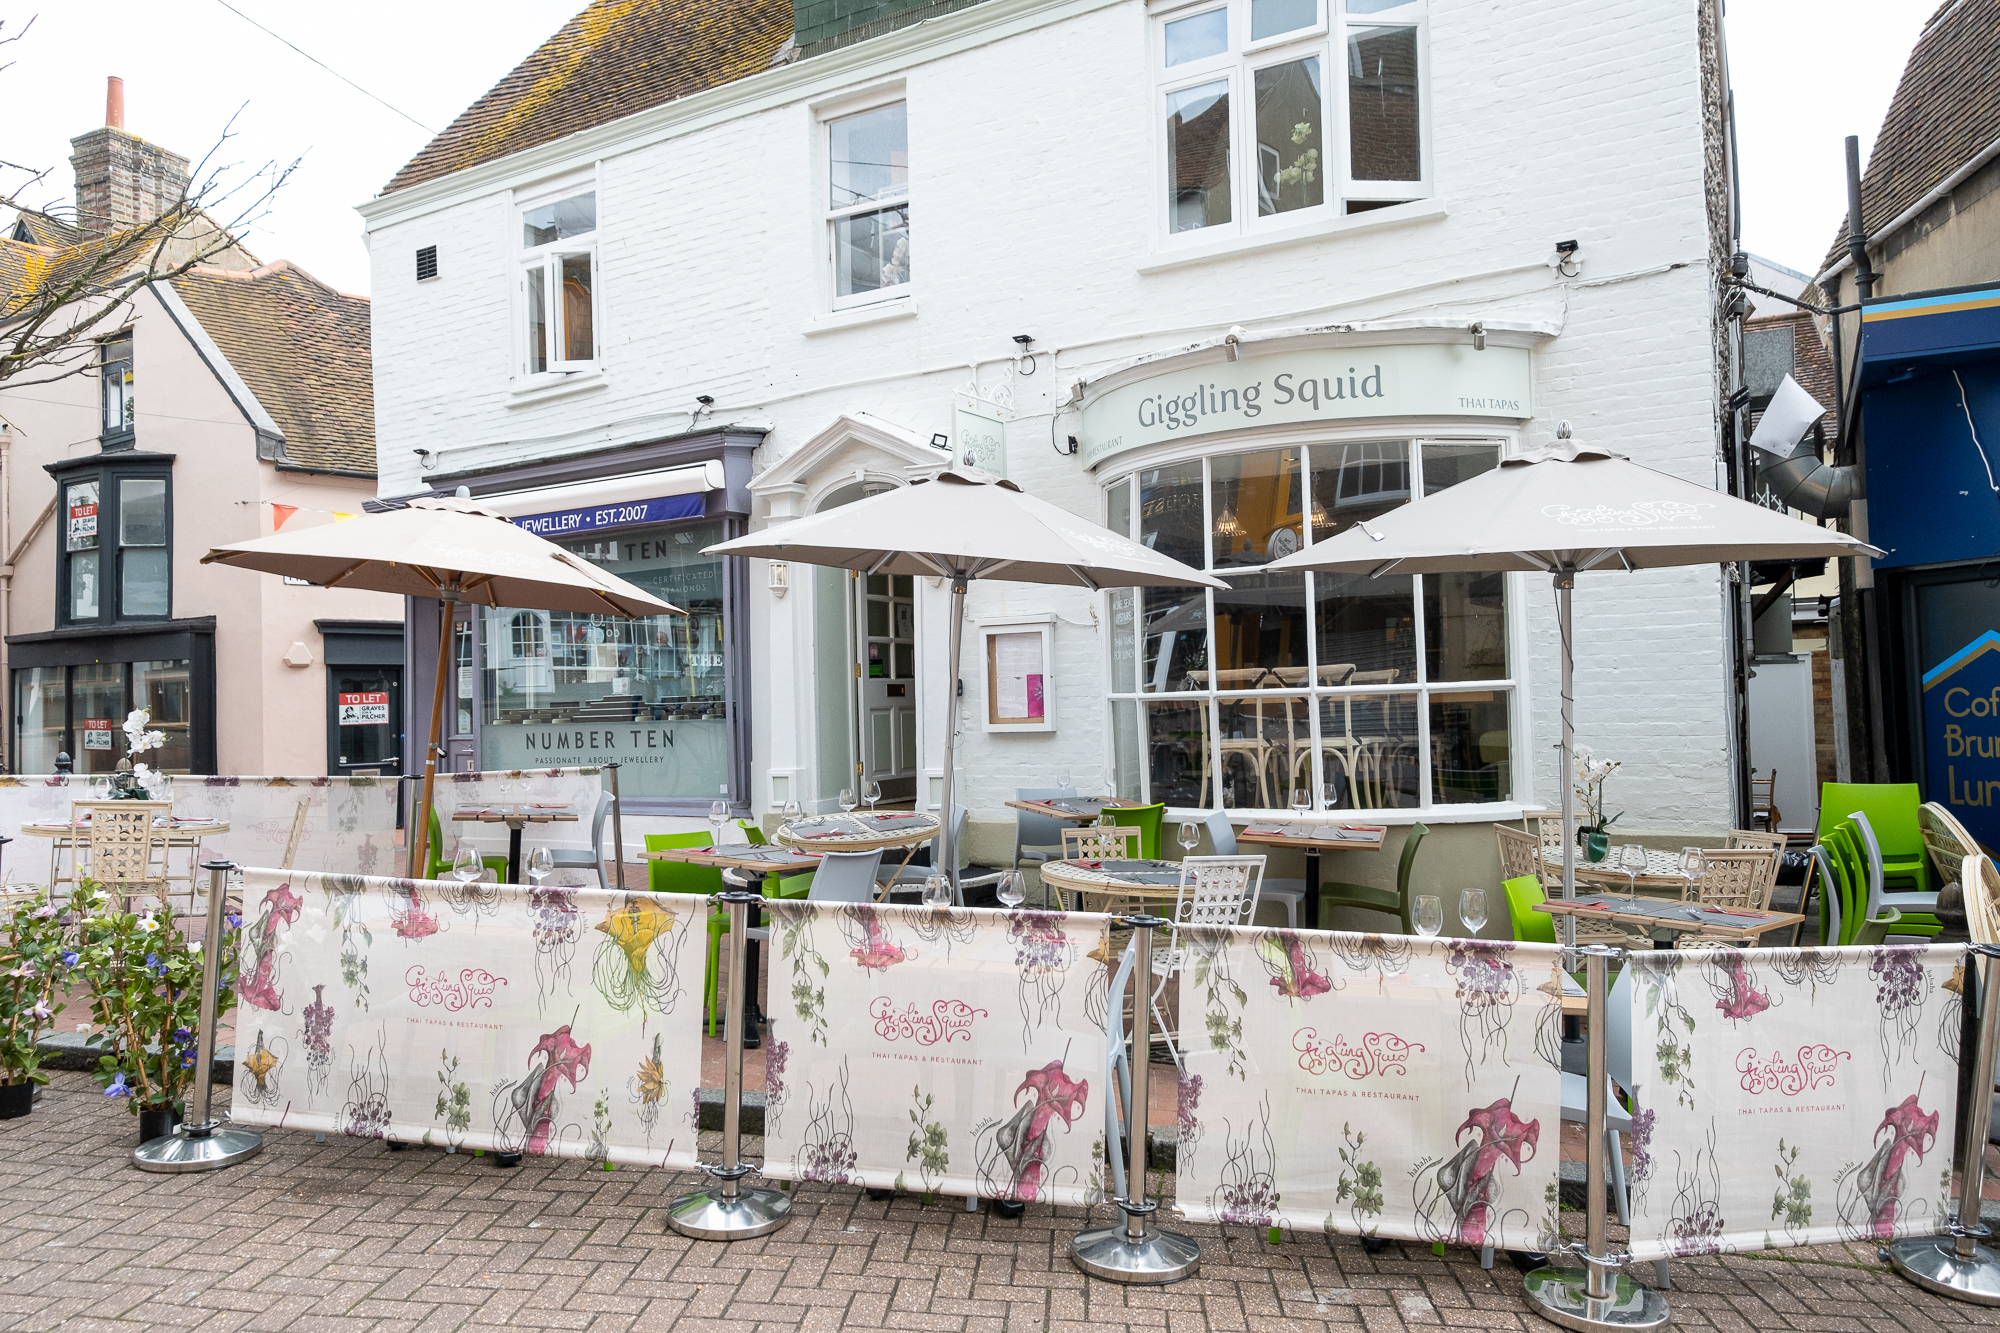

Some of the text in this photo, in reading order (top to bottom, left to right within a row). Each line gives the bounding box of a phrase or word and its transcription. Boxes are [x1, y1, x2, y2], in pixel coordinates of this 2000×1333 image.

[1138, 364, 1385, 430] Giggling Squid
[1458, 397, 1520, 411] THAI TAPAS
[1092, 436, 1122, 457] RESTAURANT
[74, 506, 94, 517] TO LET
[522, 514, 582, 532] JEWELLERY
[624, 540, 667, 561] TEN
[652, 570, 714, 584] CERTIFICATED
[660, 585, 707, 596] DIAMONDS
[690, 654, 723, 666] THE
[346, 694, 381, 704] TO LET
[1944, 686, 2000, 718] Cof
[88, 720, 108, 729] TO LET
[526, 730, 674, 750] NUMBER TEN
[535, 756, 664, 764] PASSIONATE ABOUT JEWELLERY
[404, 964, 508, 1012] Giggling Squid
[1517, 969, 1529, 995] hahaha
[1926, 968, 1936, 994] hahaha
[456, 1022, 503, 1030] RESTAURANT
[870, 996, 988, 1046] Giggling Squid
[894, 1054, 918, 1062] TAPAS
[930, 1056, 983, 1066] RESTAURANT
[1292, 1026, 1425, 1080] Giggling Squid
[1736, 1044, 1851, 1096] Giggling Squid
[489, 1078, 509, 1097] hahaha
[1321, 1089, 1348, 1097] TAPAS
[1361, 1091, 1420, 1102] RESTAURANT
[1738, 1108, 1756, 1116] THAI
[1796, 1104, 1846, 1113] RESTAURANT
[970, 1116, 993, 1137] hahaha
[1407, 1156, 1433, 1178] hahaha
[1832, 1161, 1855, 1184] hahaha
